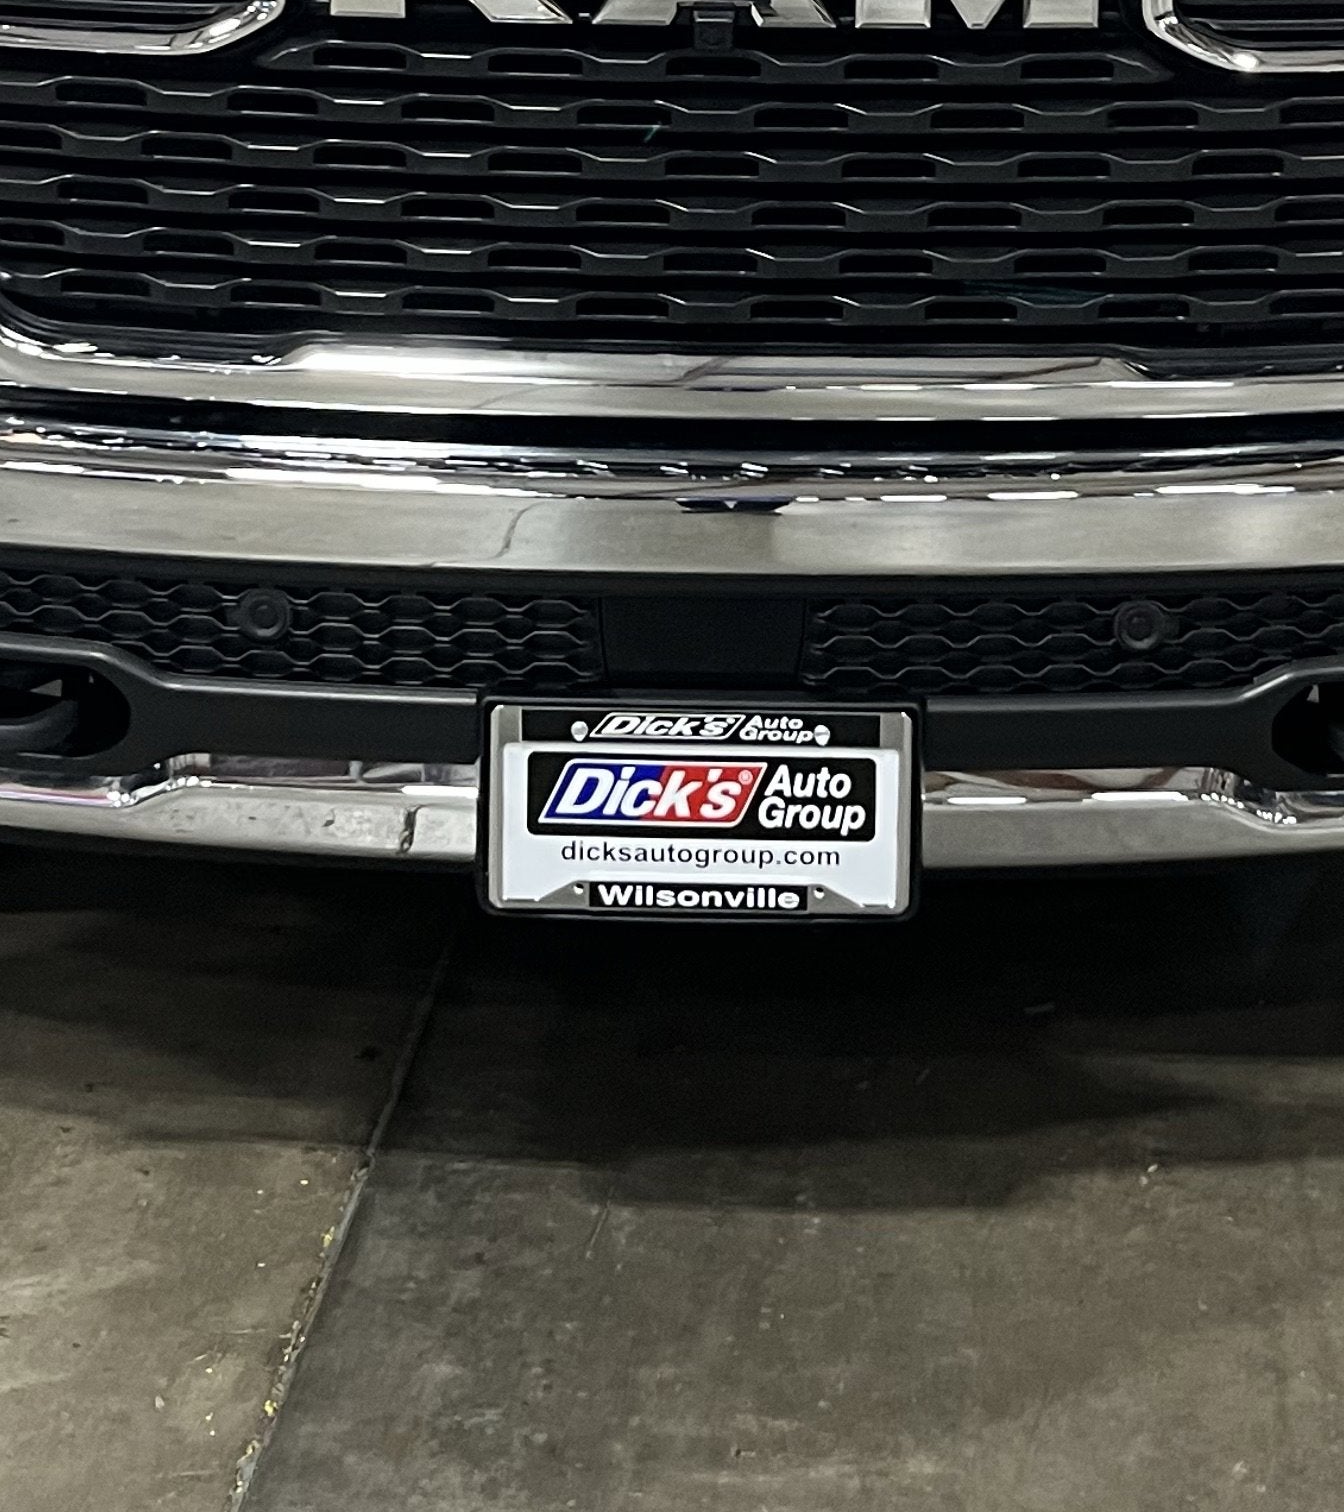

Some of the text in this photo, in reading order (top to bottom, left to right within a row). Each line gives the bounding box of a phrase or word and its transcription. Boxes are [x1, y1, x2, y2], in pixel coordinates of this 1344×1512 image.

[739, 727, 814, 744] Group
[747, 714, 804, 730] Auto
[764, 764, 852, 798] Auto
[757, 796, 867, 836] Group
[561, 840, 840, 869] dicksautogroup.com
[597, 883, 801, 910] Wilsonville
